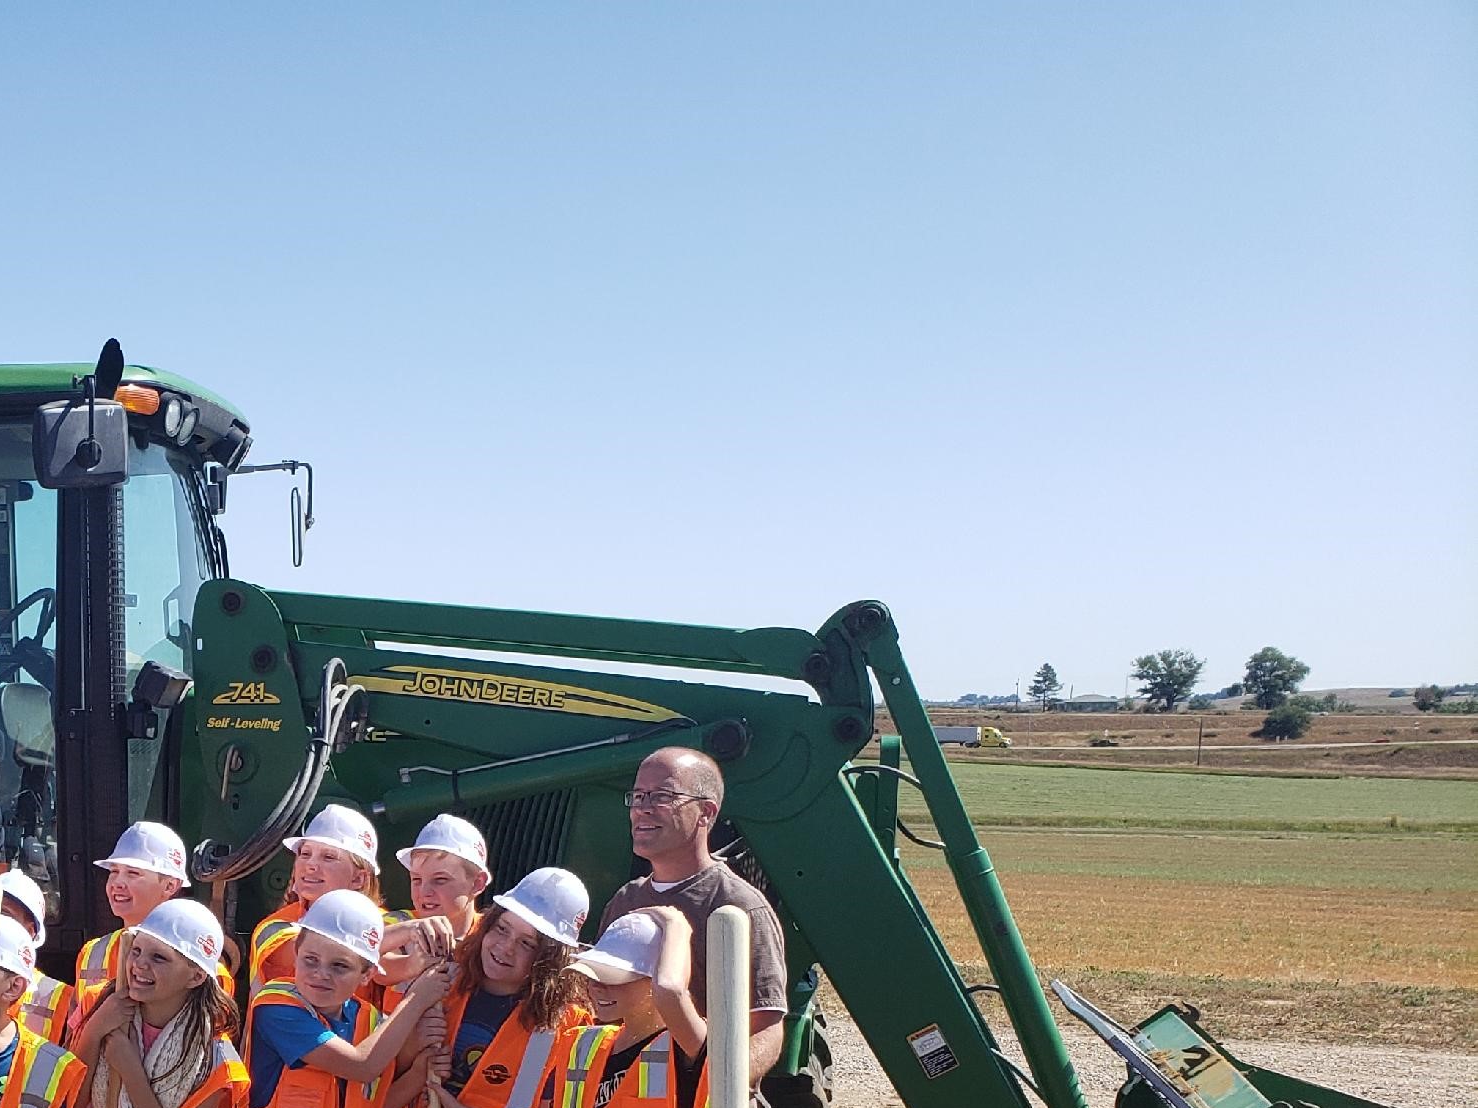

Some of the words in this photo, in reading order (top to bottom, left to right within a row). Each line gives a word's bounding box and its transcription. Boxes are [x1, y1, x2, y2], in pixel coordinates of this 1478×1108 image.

[228, 682, 265, 700] 741
[402, 671, 478, 699] JOHN
[481, 678, 566, 708] DEERE
